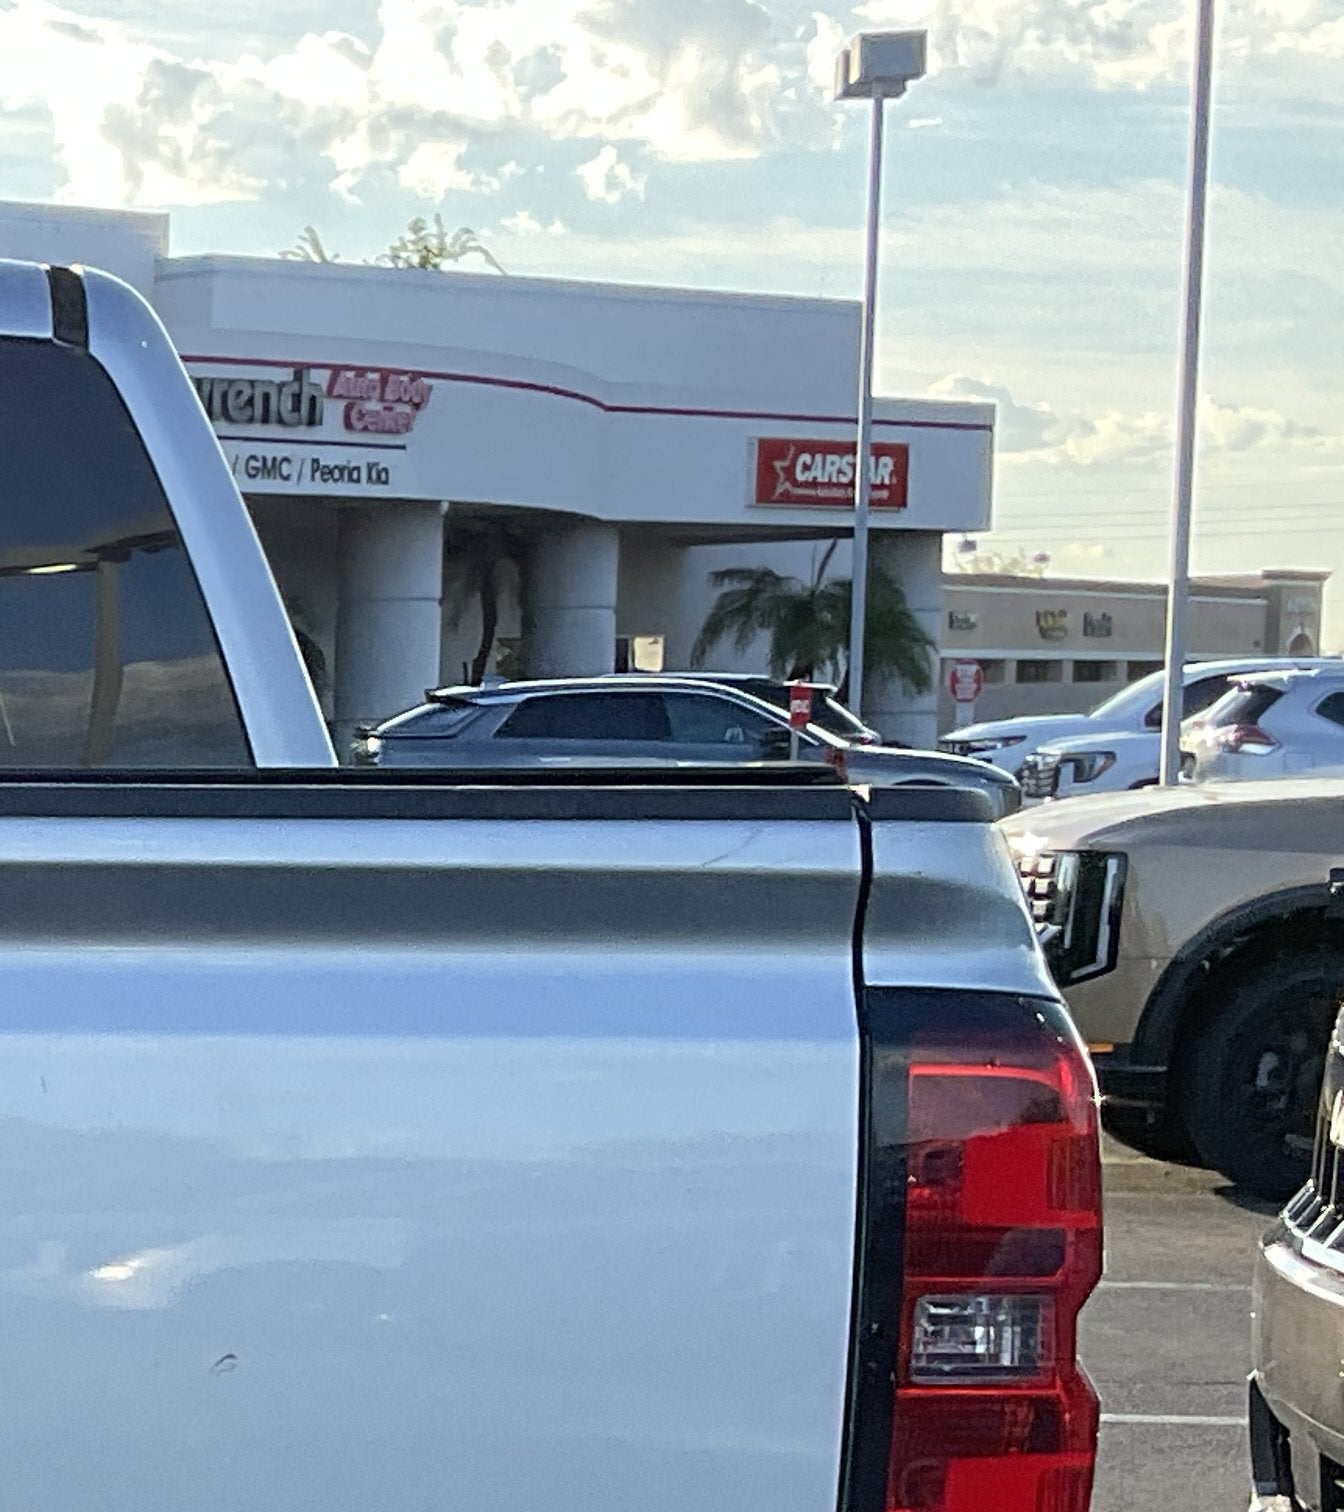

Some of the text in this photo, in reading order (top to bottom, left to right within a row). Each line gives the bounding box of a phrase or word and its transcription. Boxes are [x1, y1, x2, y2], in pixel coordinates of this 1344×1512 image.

[244, 454, 293, 482] GMC
[311, 457, 361, 485] Peoria
[366, 461, 390, 486] Kia
[795, 452, 895, 486] CARSAR
